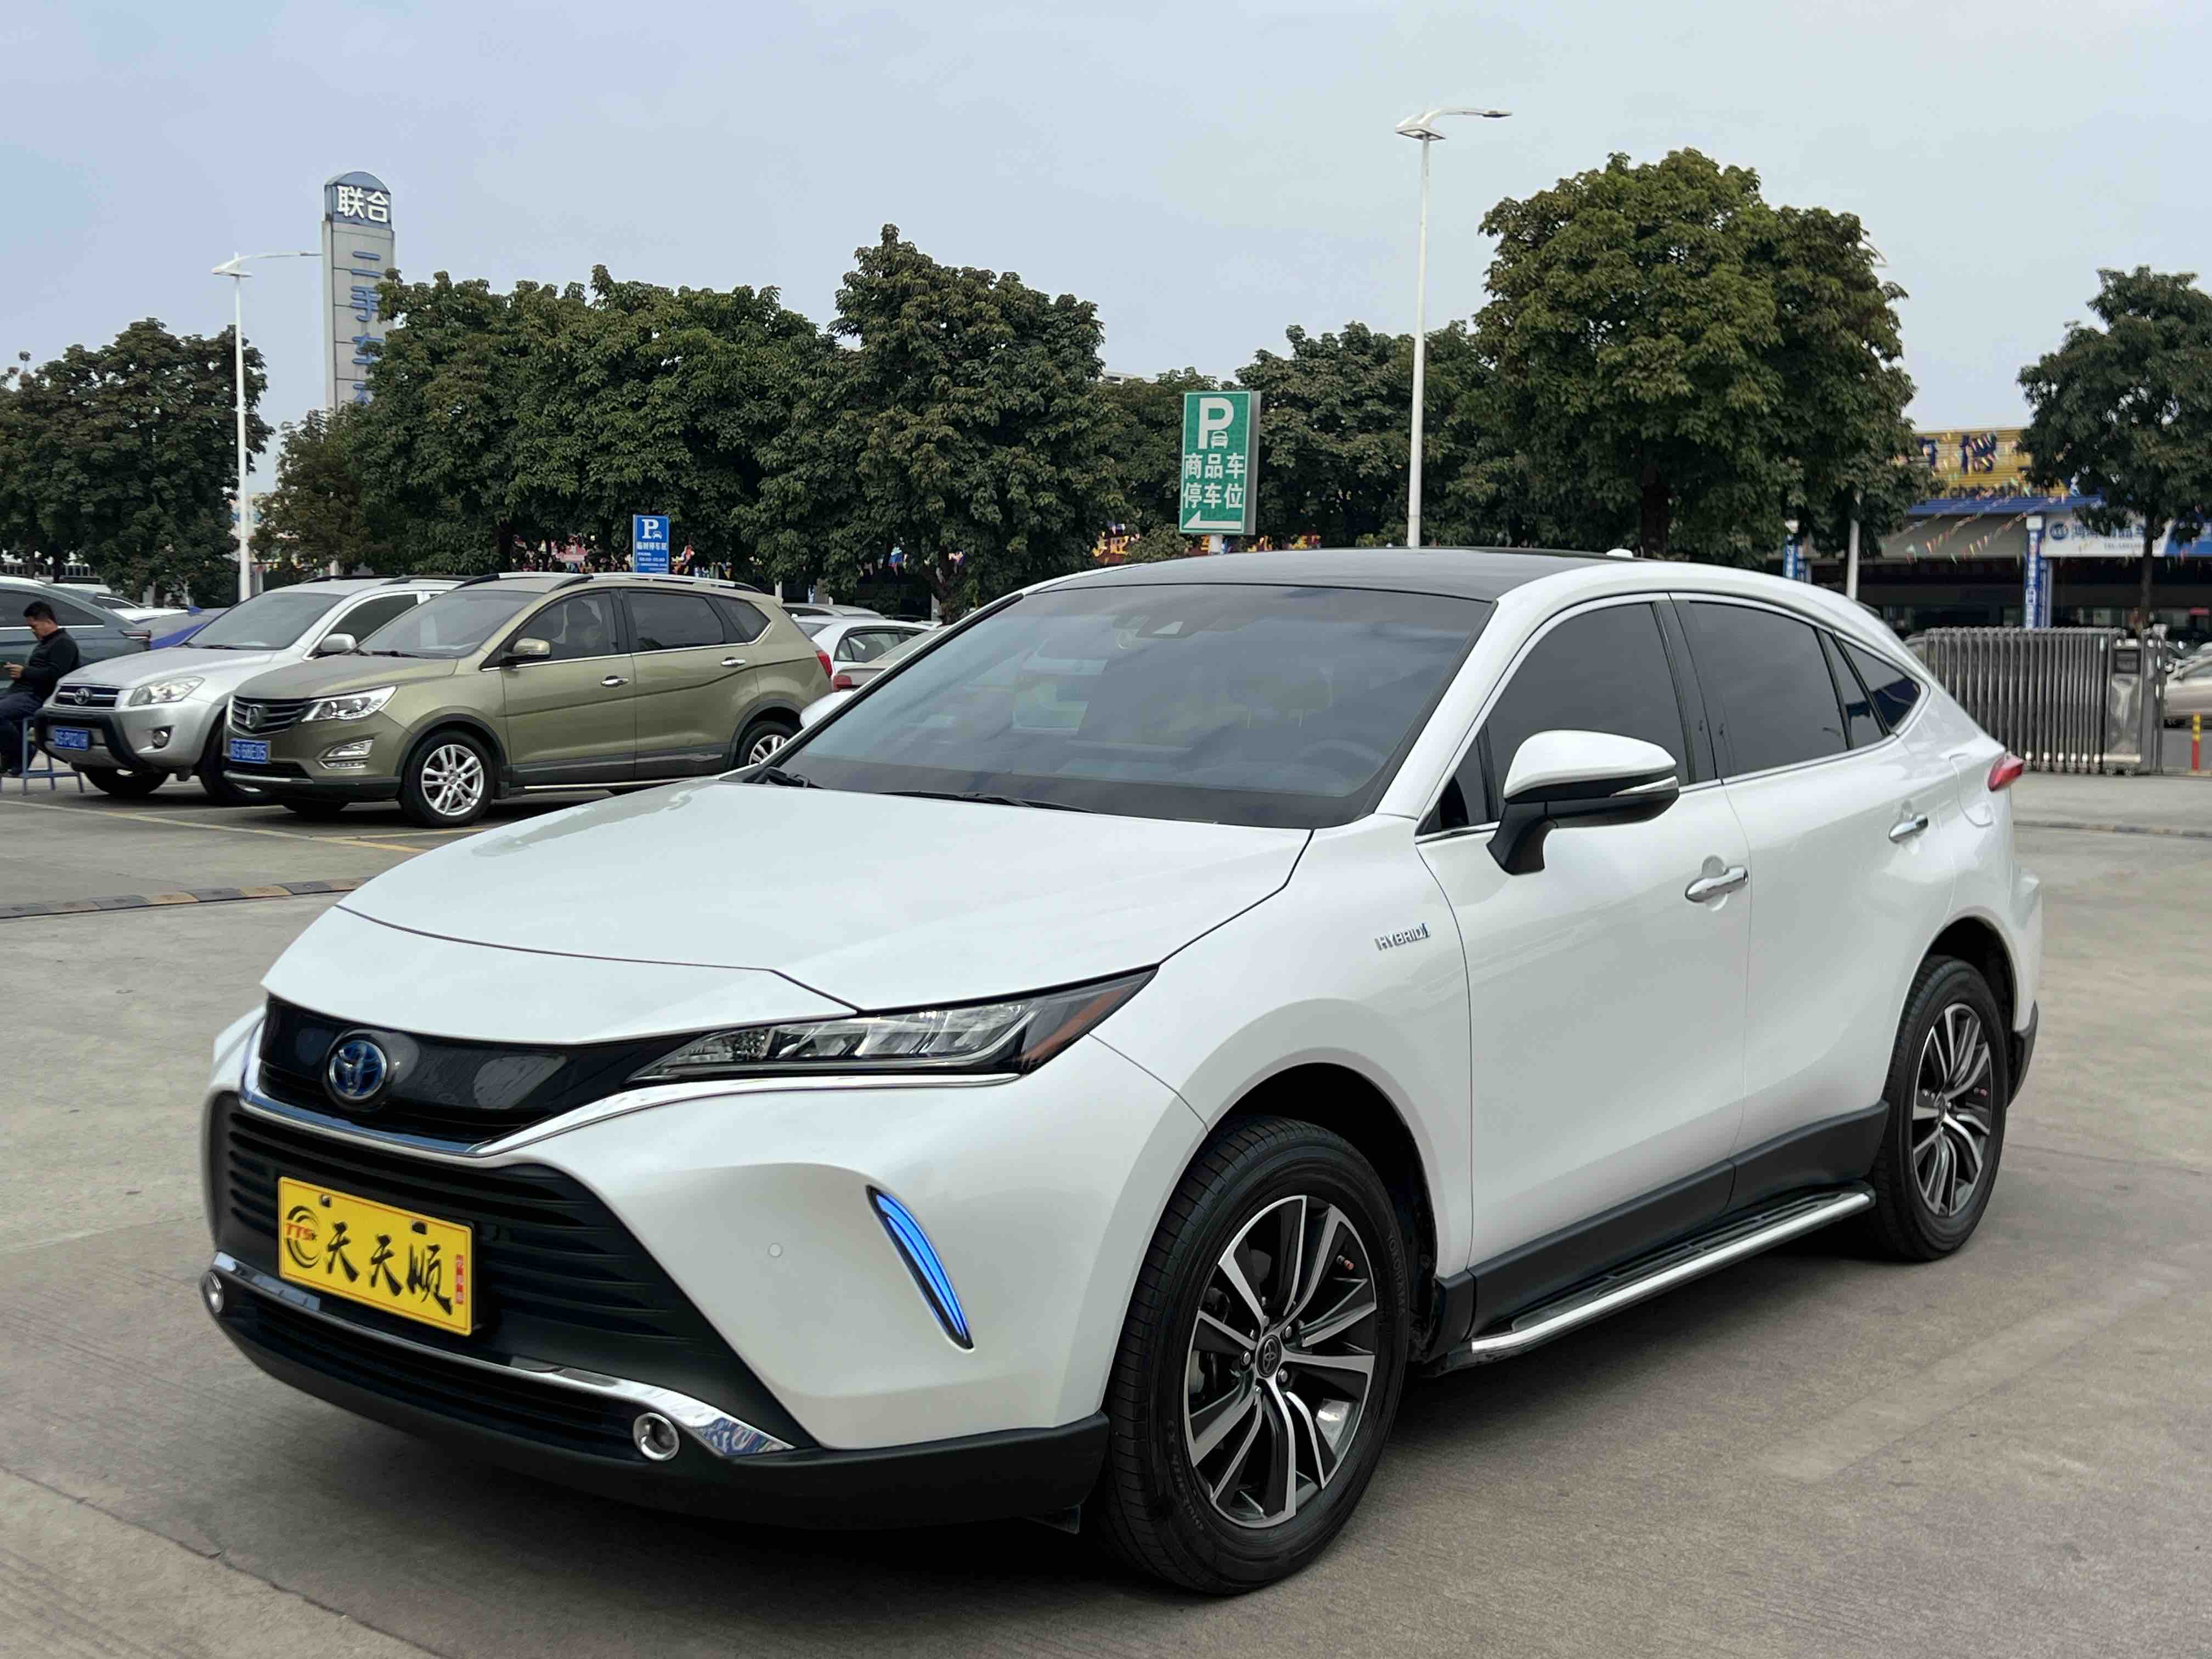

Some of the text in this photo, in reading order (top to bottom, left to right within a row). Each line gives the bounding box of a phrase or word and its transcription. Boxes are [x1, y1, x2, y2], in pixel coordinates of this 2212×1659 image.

[337, 185, 389, 223] 联合
[1198, 397, 1234, 450] P
[1184, 452, 1245, 479] 商品车
[1183, 482, 1243, 509] 停车位
[641, 518, 659, 539] P
[1374, 926, 1425, 951] HYBRID
[326, 1221, 453, 1316] 天天顺
